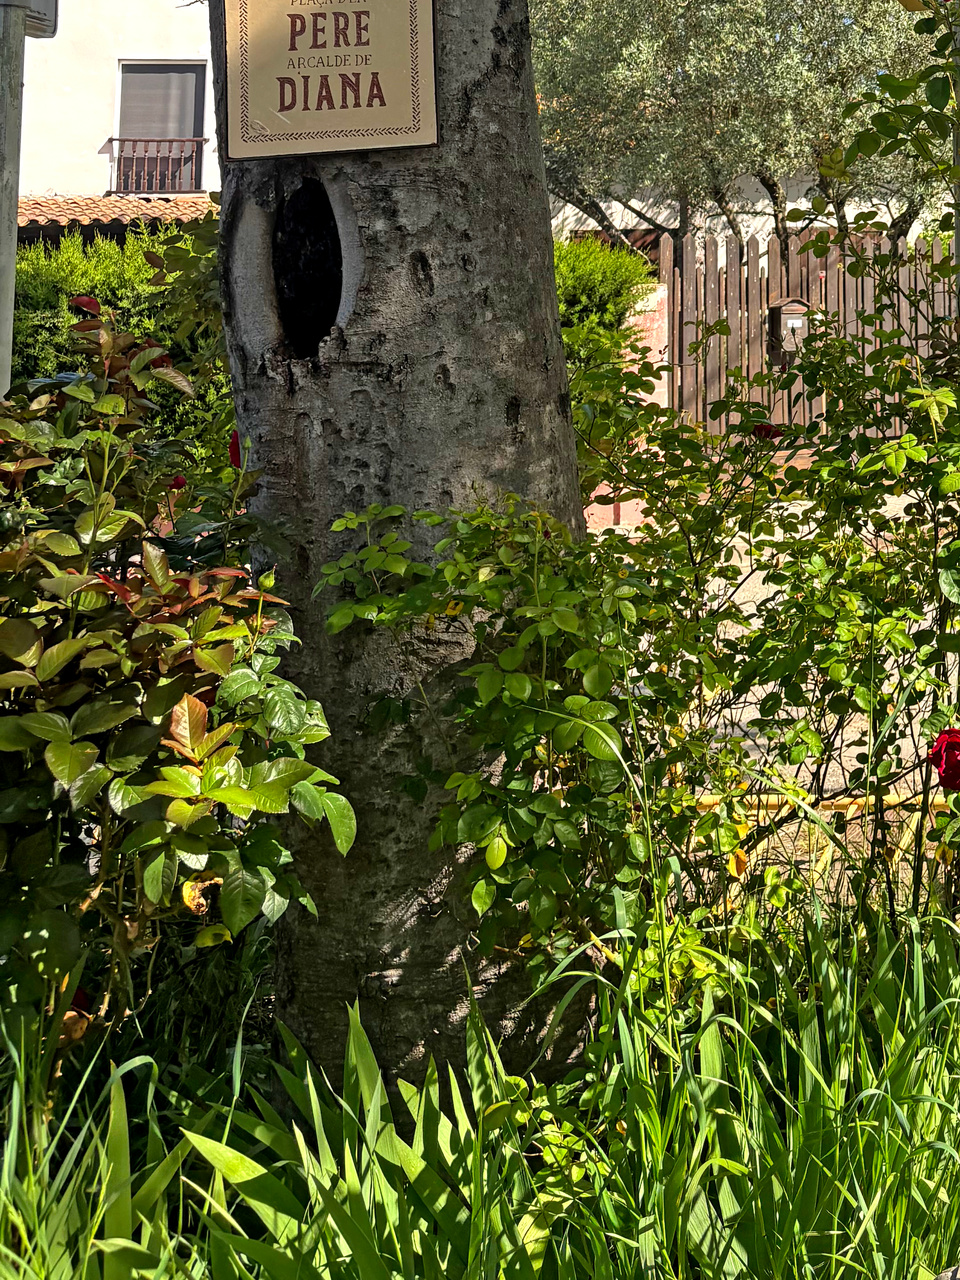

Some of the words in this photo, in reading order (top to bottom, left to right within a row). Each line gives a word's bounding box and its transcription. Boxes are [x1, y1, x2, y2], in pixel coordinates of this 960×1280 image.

[287, 11, 370, 51] PERE
[287, 55, 351, 70] ARCALDE
[355, 54, 372, 66] DE
[276, 72, 387, 113] DIANA
